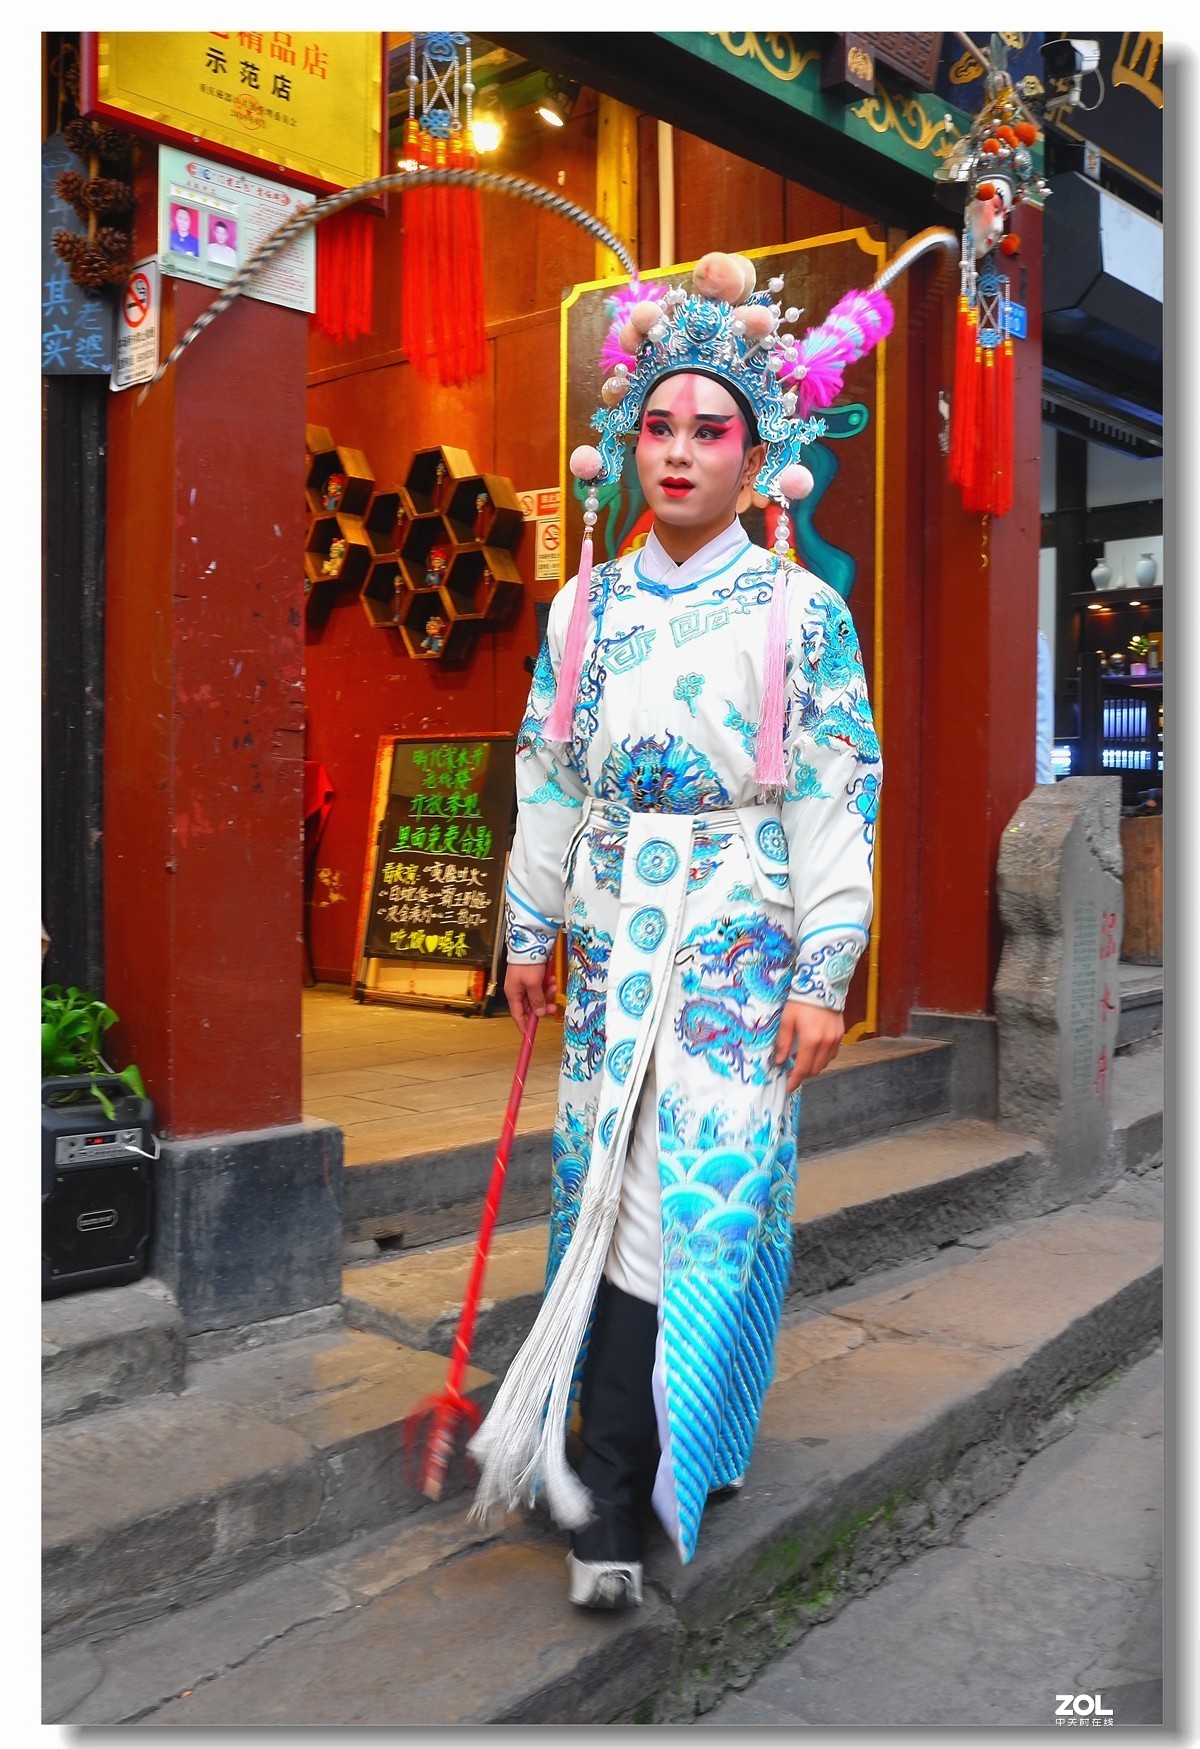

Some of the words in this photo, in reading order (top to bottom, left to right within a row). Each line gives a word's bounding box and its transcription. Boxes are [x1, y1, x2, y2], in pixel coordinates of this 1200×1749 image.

[206, 46, 292, 102] 示范店
[209, 31, 329, 80] 精品店
[392, 824, 492, 859] 里面免费合影
